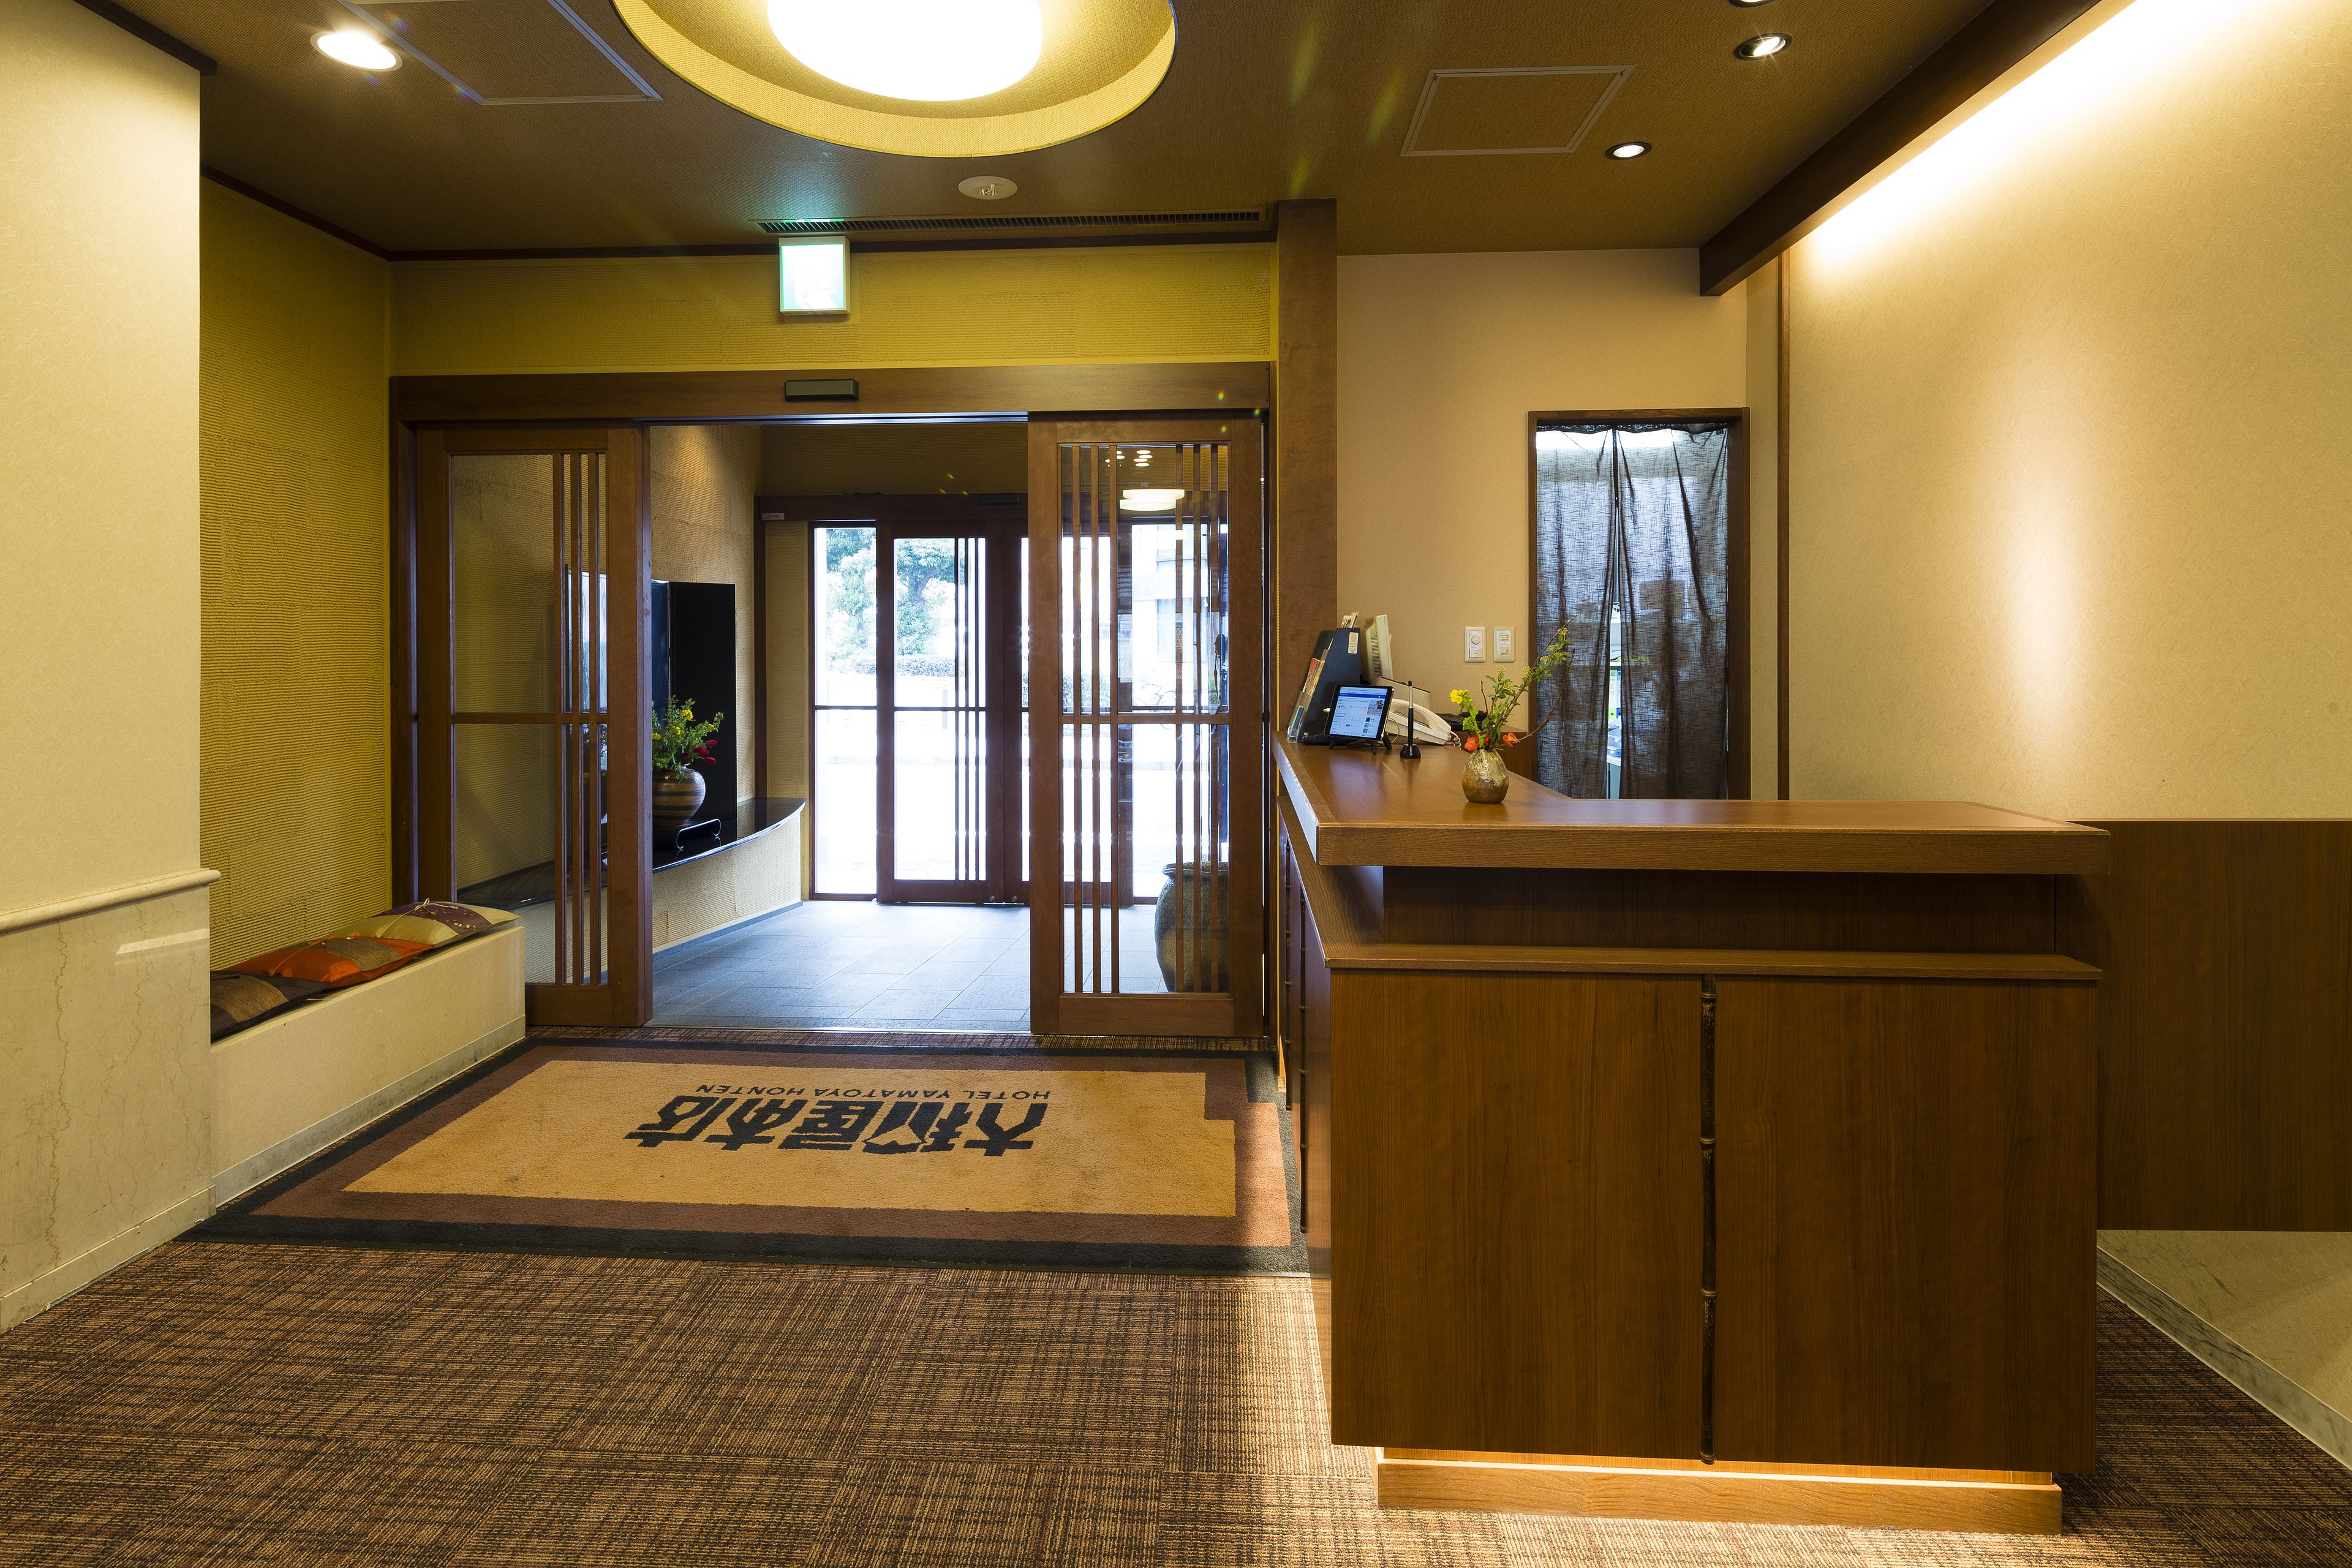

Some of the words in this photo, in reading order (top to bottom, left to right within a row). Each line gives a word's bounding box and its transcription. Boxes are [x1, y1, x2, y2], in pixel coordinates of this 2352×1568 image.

[695, 1084, 805, 1096] HONTEN
[814, 1088, 951, 1099] YAMATOYA
[962, 1090, 1050, 1100] HOTEL
[622, 1095, 1049, 1157] 大和屋本店
